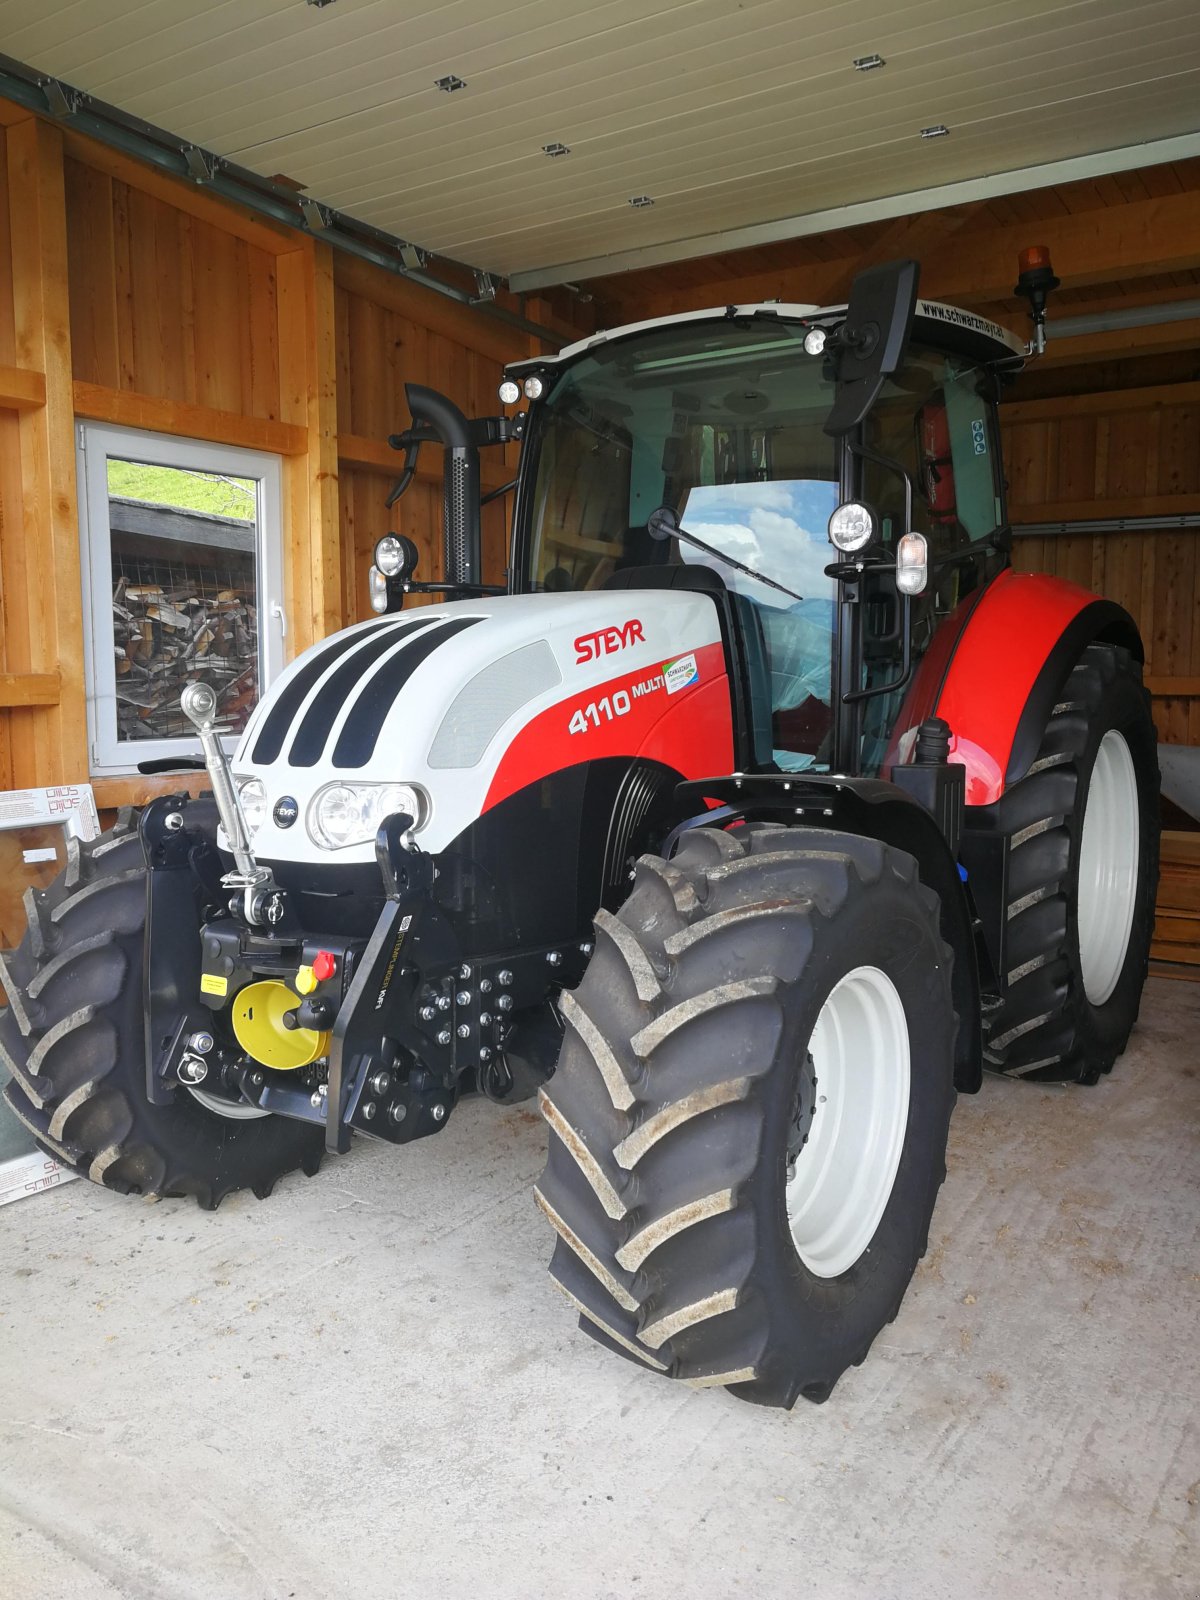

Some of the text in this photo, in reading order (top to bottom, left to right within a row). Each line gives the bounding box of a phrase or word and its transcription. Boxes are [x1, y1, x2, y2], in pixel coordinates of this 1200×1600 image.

[574, 619, 646, 665] STEYR
[568, 674, 665, 735] 4110 MULTI
[275, 807, 296, 817] TEYR
